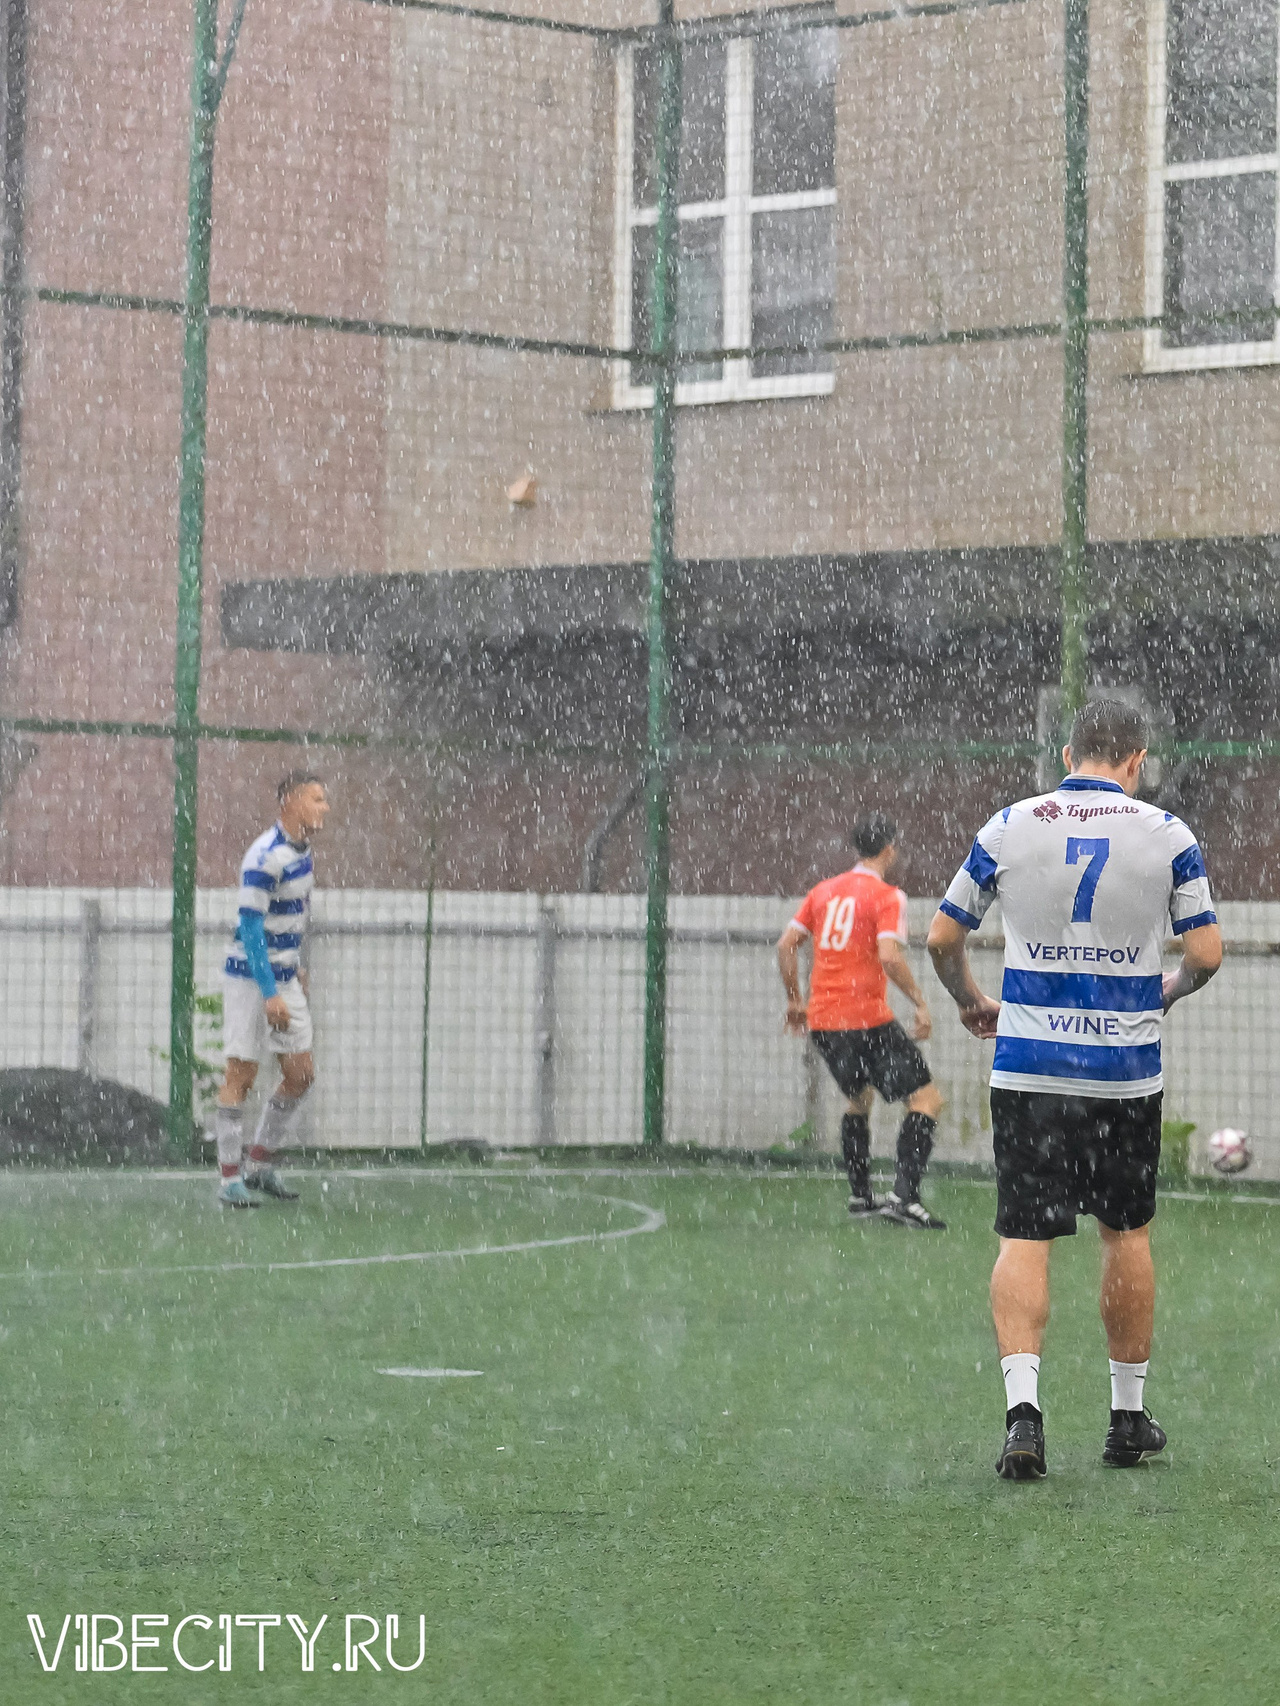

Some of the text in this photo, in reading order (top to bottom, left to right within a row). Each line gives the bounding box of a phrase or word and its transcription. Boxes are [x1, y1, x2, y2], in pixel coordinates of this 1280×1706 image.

[1066, 804, 1140, 822] Бутыль
[1065, 837, 1110, 923] 7
[819, 895, 856, 952] 19
[1026, 942, 1140, 965] VERTEPOV
[1047, 1014, 1120, 1036] WINE
